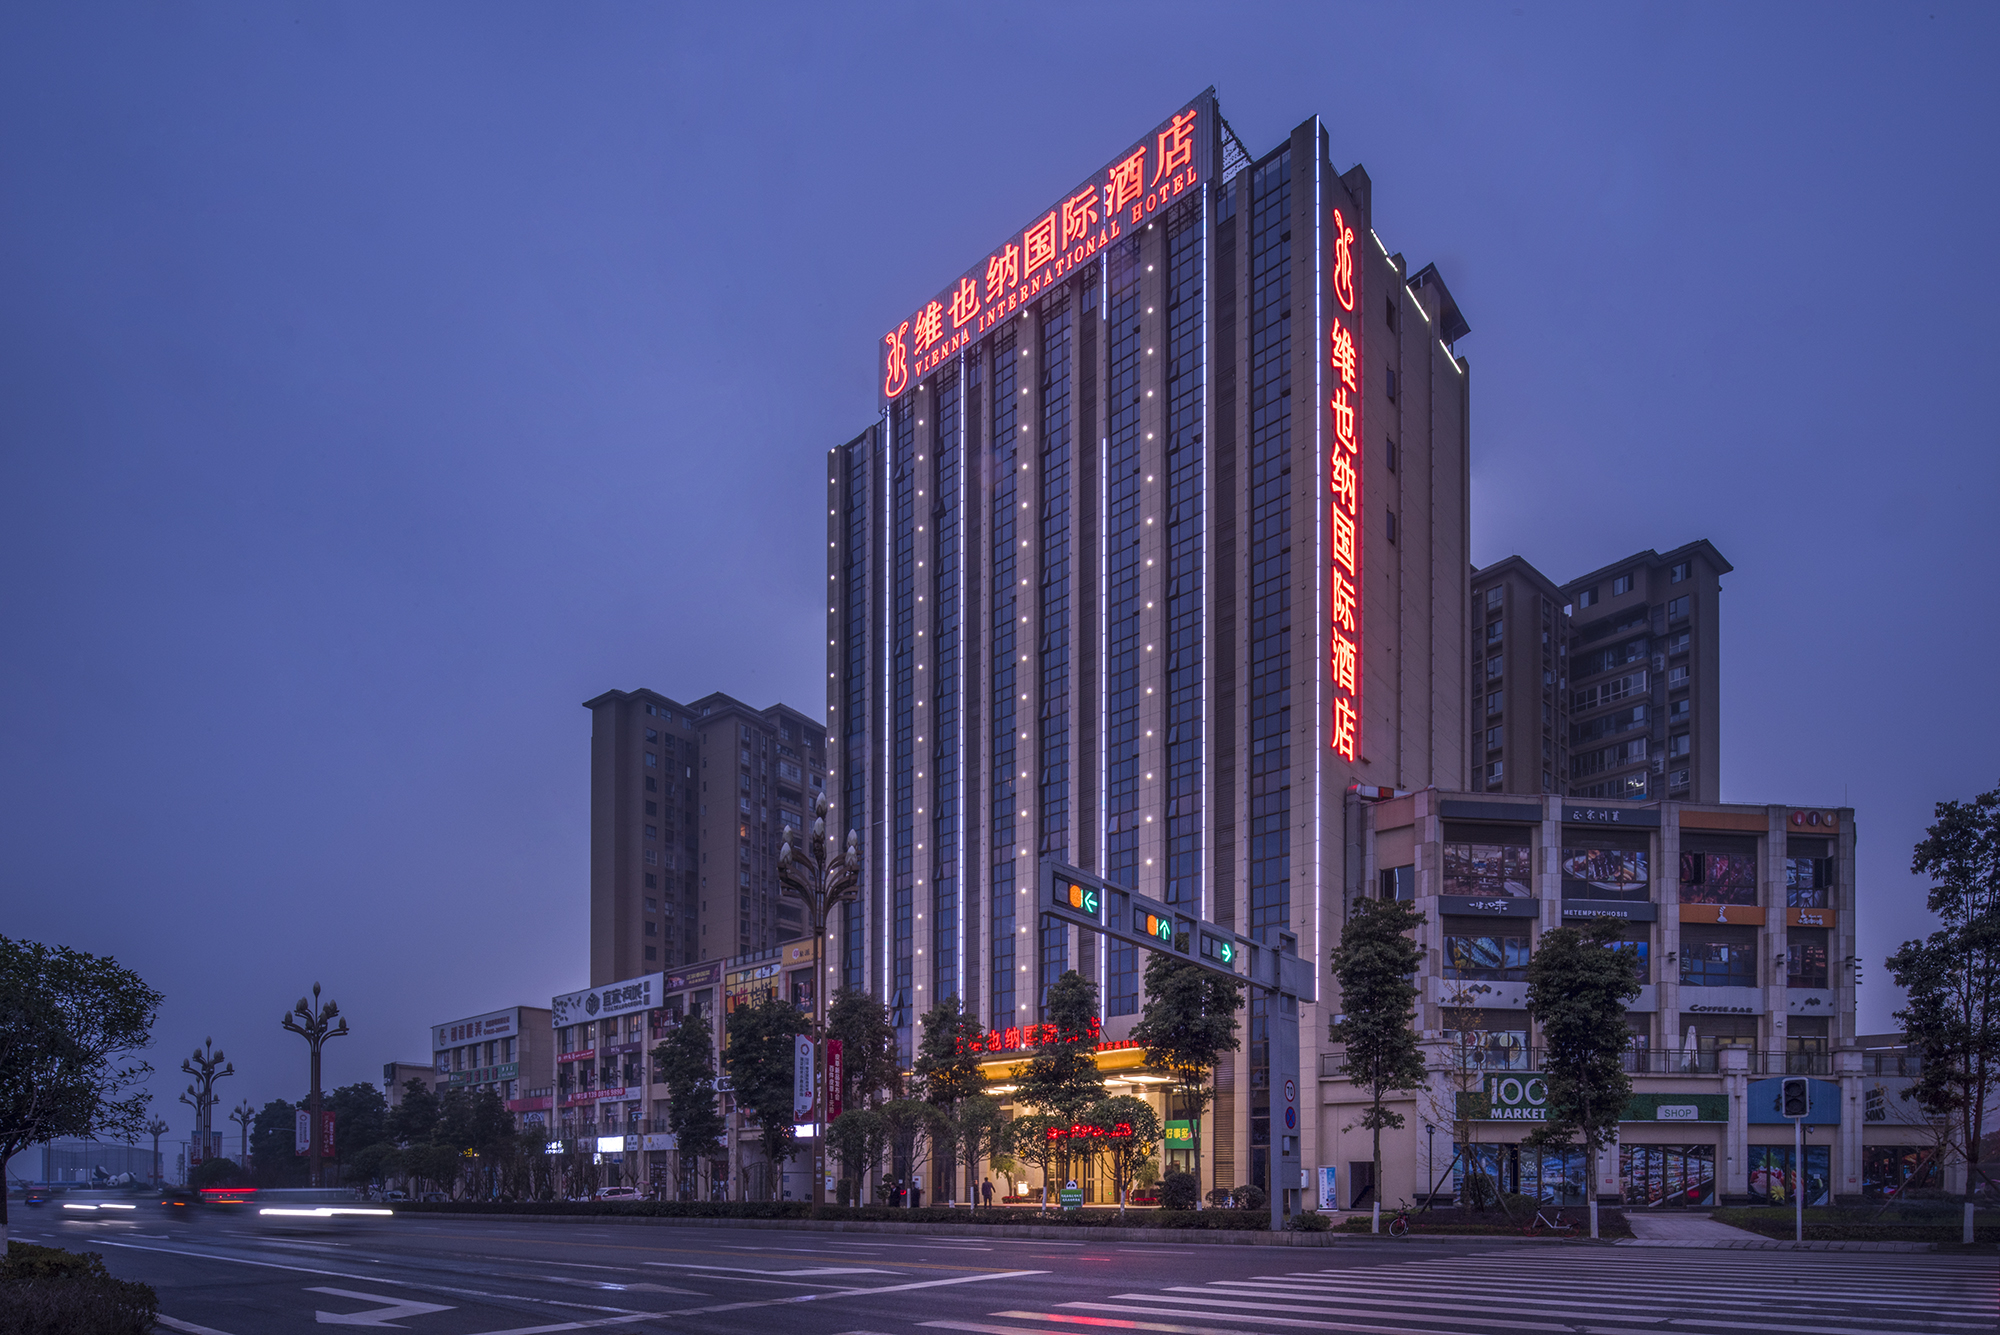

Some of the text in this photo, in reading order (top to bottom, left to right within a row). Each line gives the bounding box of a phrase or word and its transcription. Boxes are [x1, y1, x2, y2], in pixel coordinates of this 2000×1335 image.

[913, 110, 1197, 356] 维也纳国际酒店
[914, 164, 1198, 378] VIENNA INTERNATIONAL HOTEL
[1331, 318, 1360, 763] 维也纳国际酒店
[1563, 909, 1628, 917] METEMPSYCHOSIS
[1490, 1107, 1547, 1119] MARKET
[1664, 1108, 1692, 1118] SHOP
[1165, 1127, 1189, 1139] 好事多
